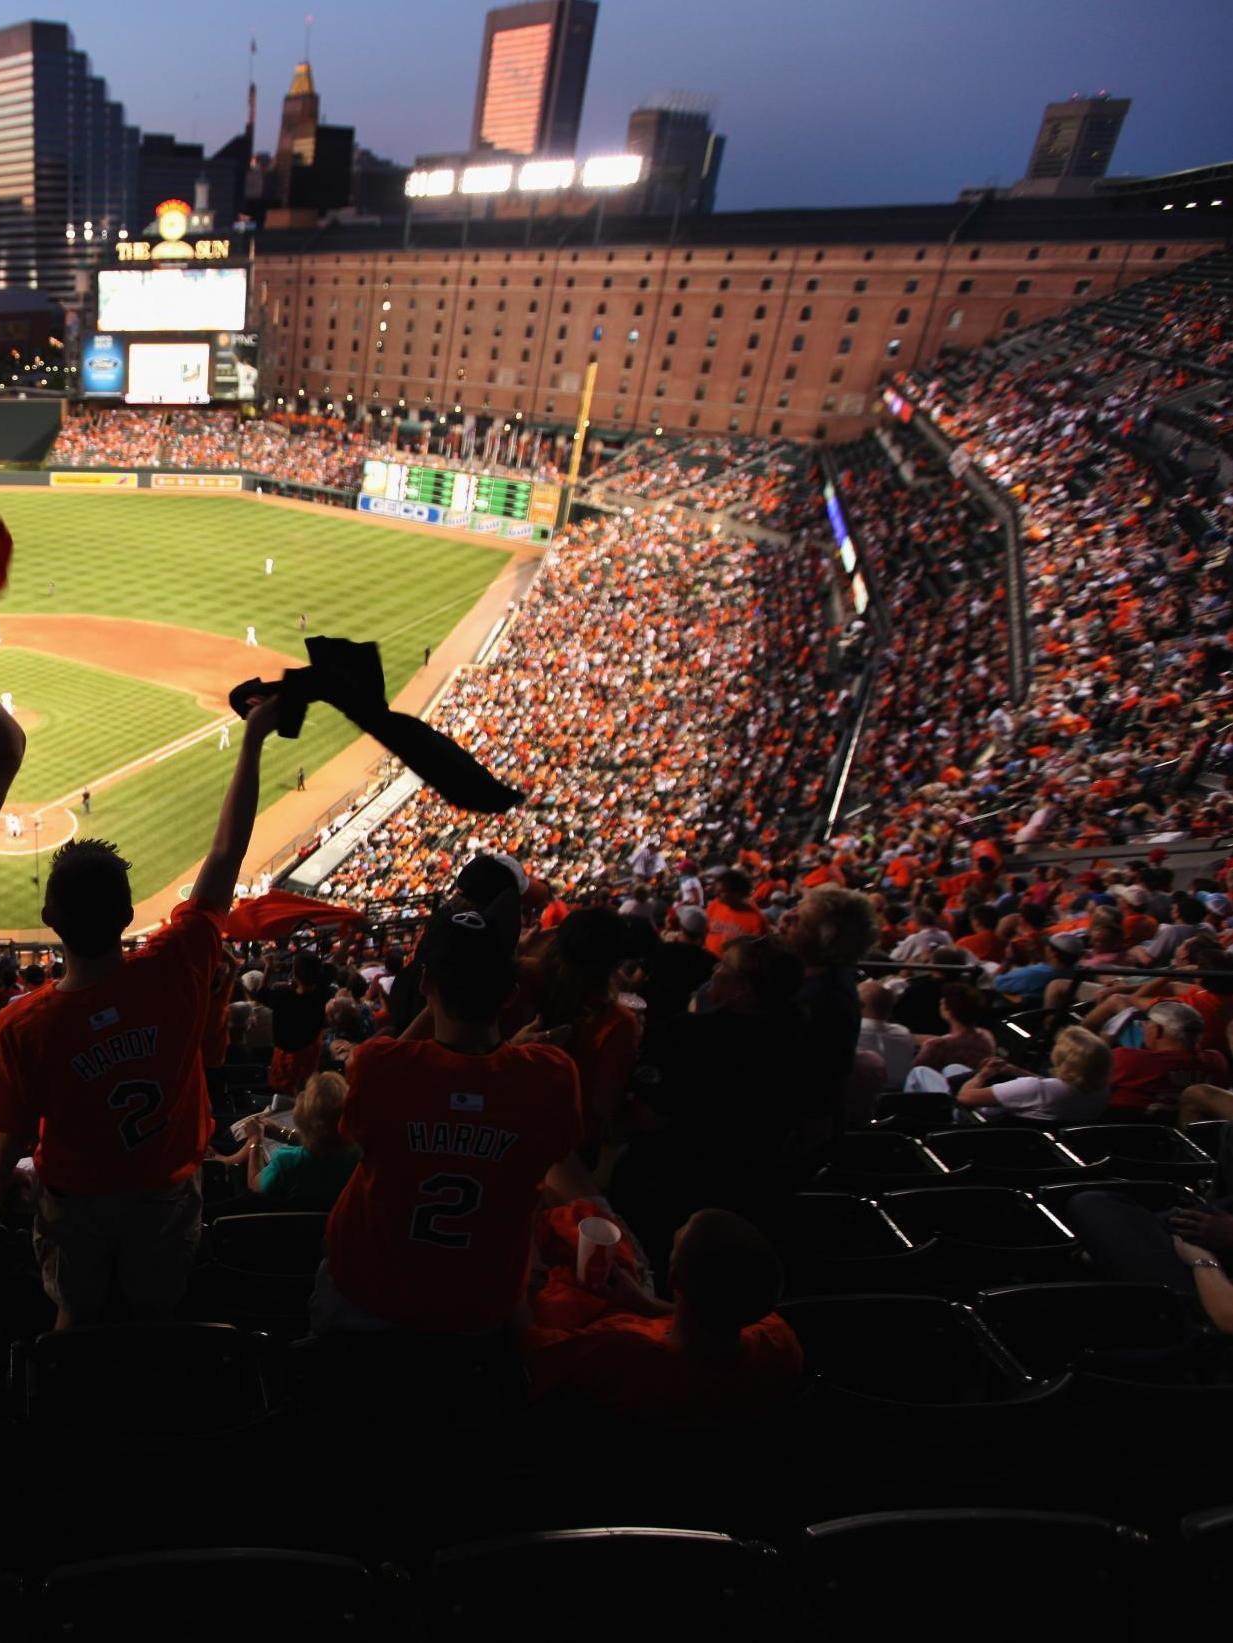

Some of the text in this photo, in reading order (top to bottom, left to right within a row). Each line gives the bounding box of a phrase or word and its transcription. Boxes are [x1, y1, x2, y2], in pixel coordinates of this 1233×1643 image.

[116, 240, 229, 260] THE SUN
[231, 333, 259, 347] PNC
[72, 1025, 159, 1082] HARDY
[107, 1079, 171, 1152] 2
[407, 1121, 518, 1163] HARDY
[408, 1172, 484, 1249] 2
